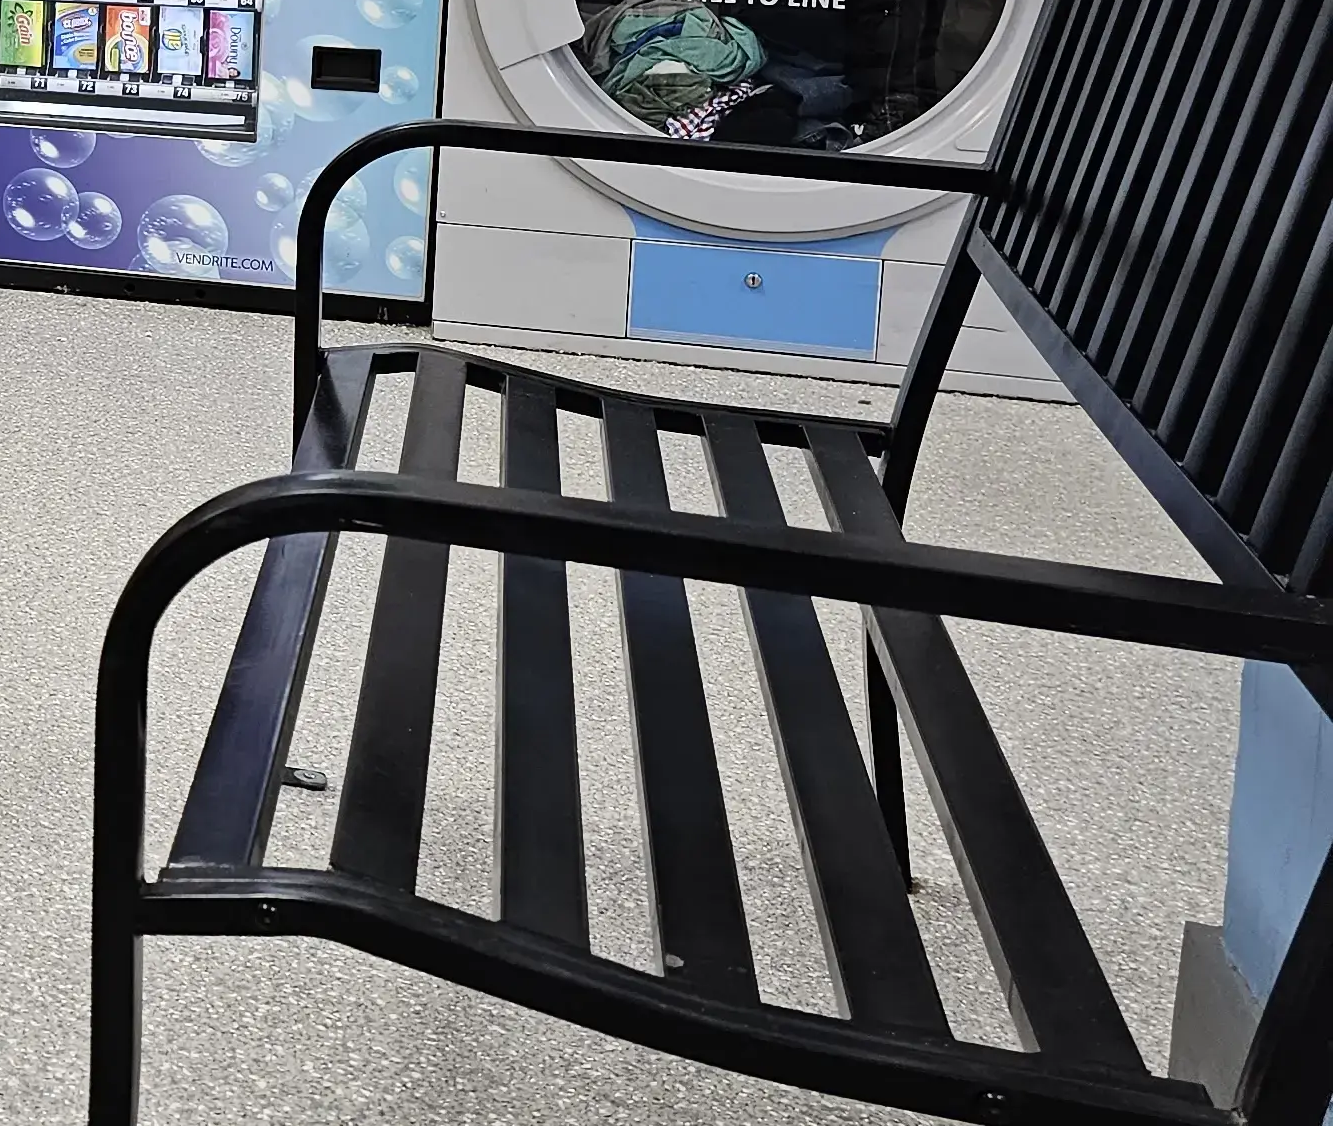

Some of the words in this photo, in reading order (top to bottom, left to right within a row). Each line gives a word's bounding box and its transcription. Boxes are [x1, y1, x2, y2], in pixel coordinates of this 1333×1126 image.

[15, 13, 33, 46] Gain
[120, 10, 139, 62] bounce
[225, 27, 242, 65] Downy
[34, 78, 46, 88] 71
[81, 80, 94, 91] 72
[125, 84, 138, 94] 73
[176, 87, 189, 97] 74
[236, 91, 248, 101] 75
[176, 250, 274, 273] VENDRITE.COM
